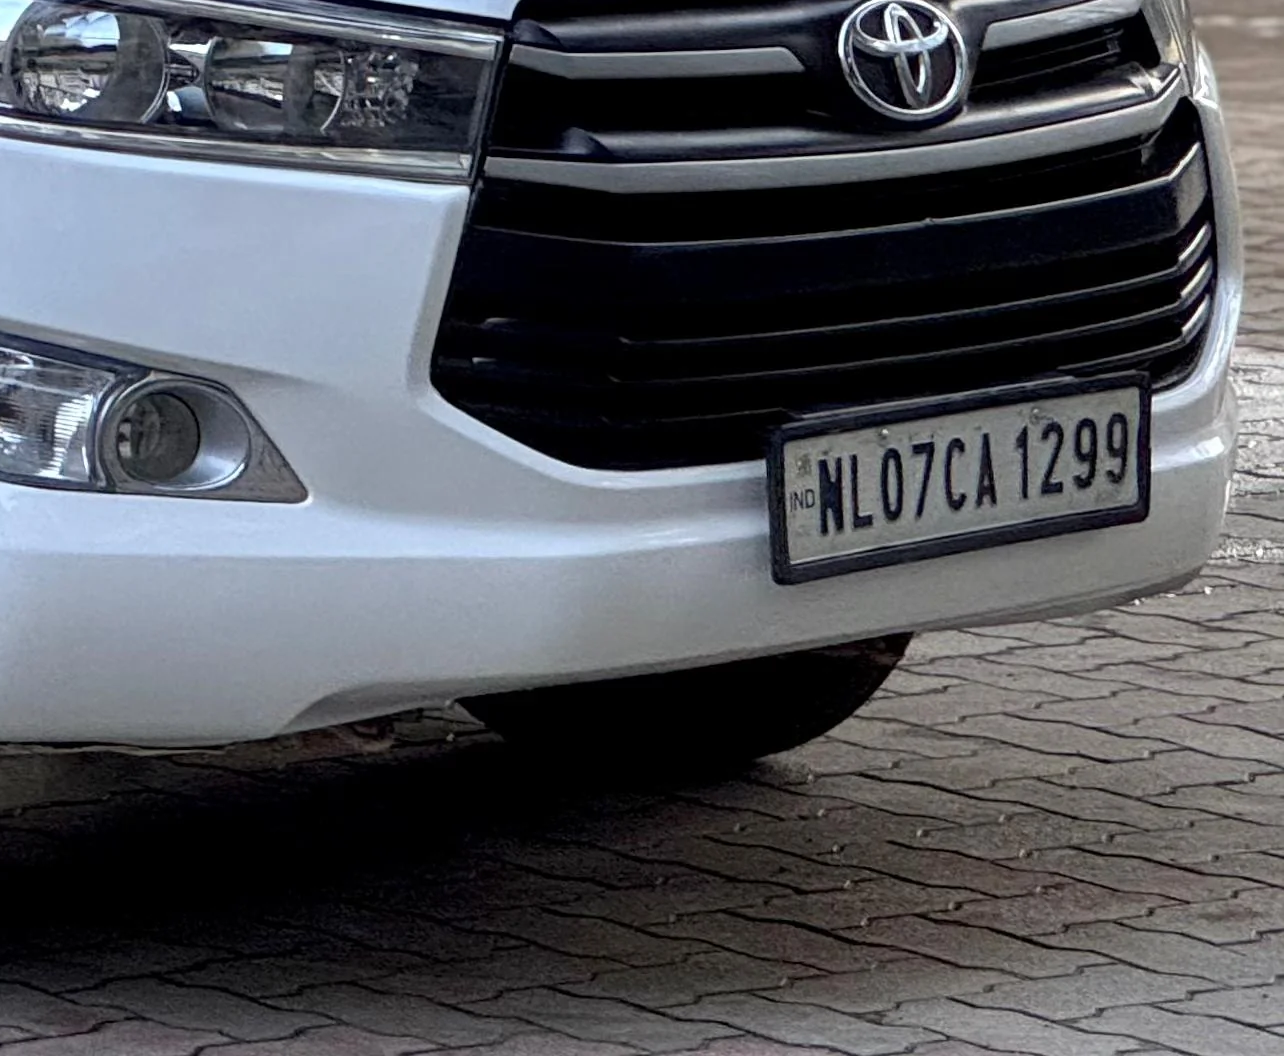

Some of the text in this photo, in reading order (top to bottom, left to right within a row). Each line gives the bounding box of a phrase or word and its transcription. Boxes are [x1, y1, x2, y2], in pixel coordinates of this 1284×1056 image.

[790, 489, 815, 513] IND
[819, 412, 1129, 536] NL07CA 1299
